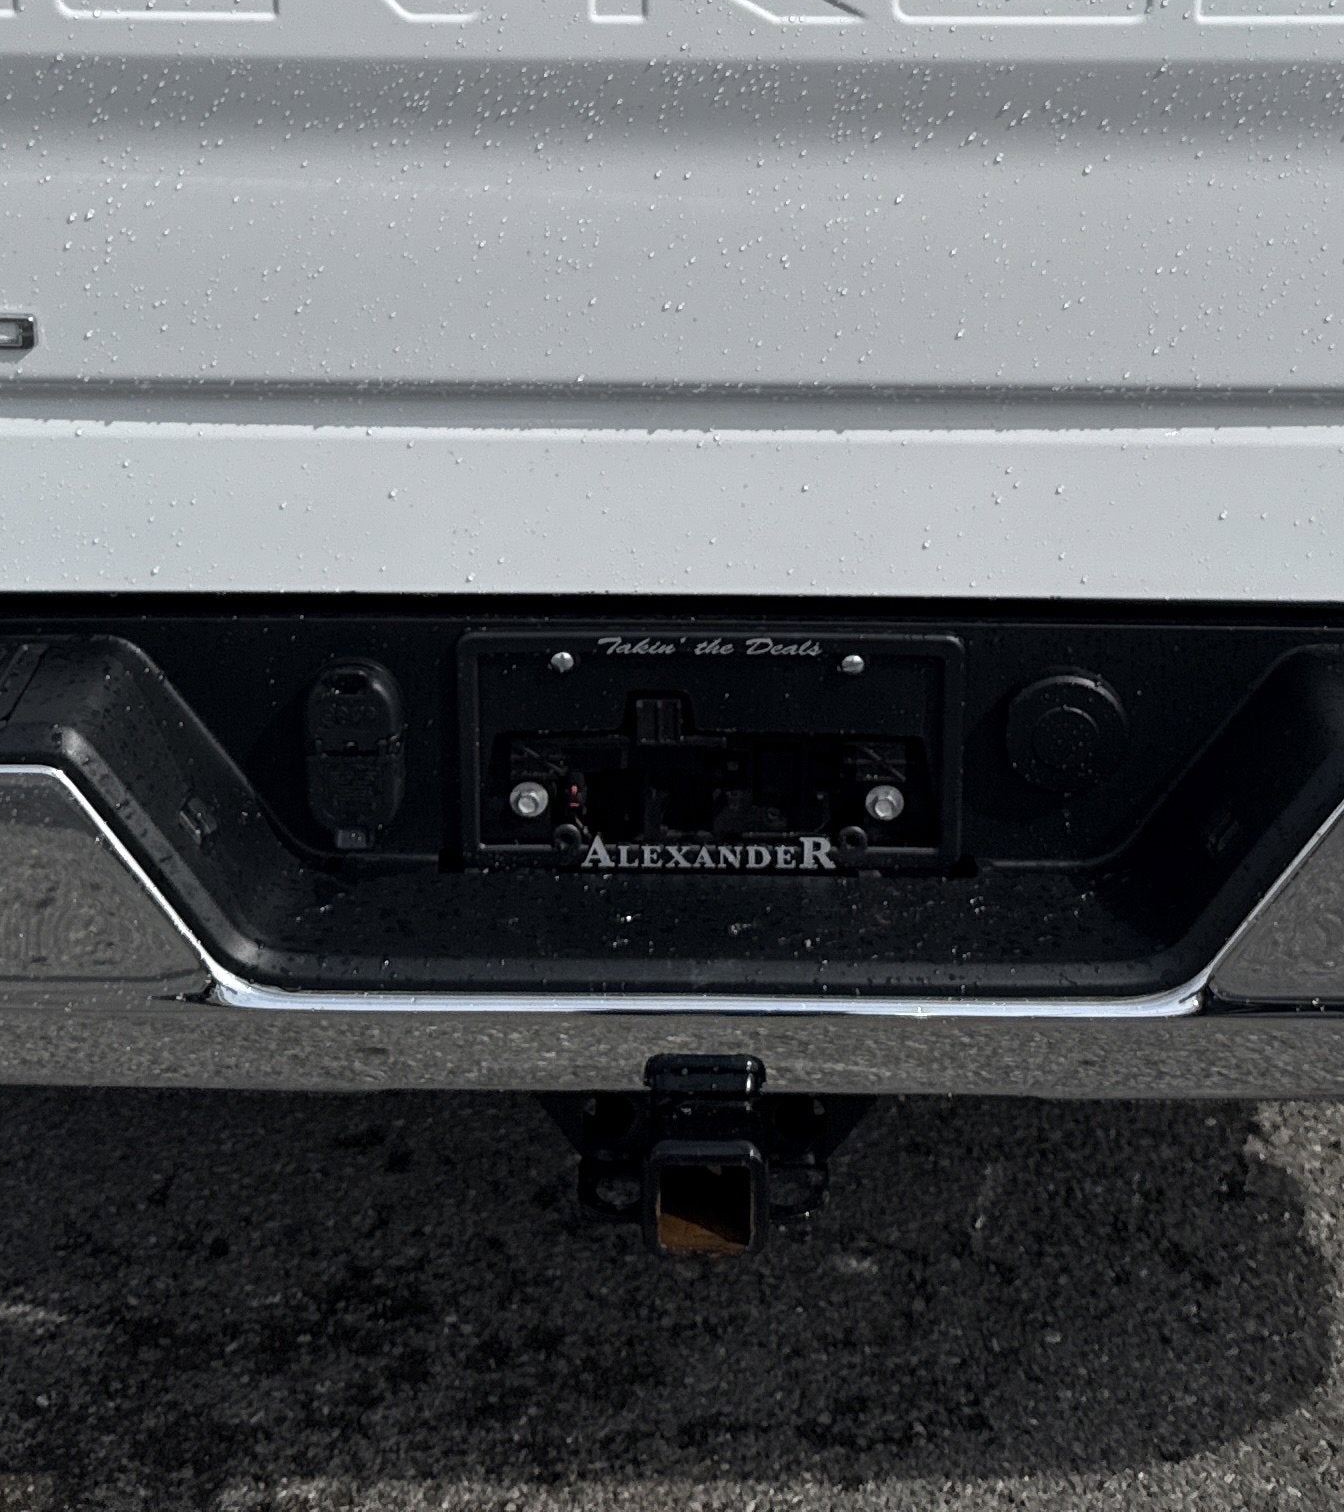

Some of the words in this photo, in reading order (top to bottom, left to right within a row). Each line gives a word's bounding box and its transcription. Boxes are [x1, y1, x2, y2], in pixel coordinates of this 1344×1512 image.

[598, 637, 687, 656] Takin'
[693, 638, 734, 655] the
[745, 637, 823, 657] Deals
[581, 835, 837, 869] ALEXANDER
